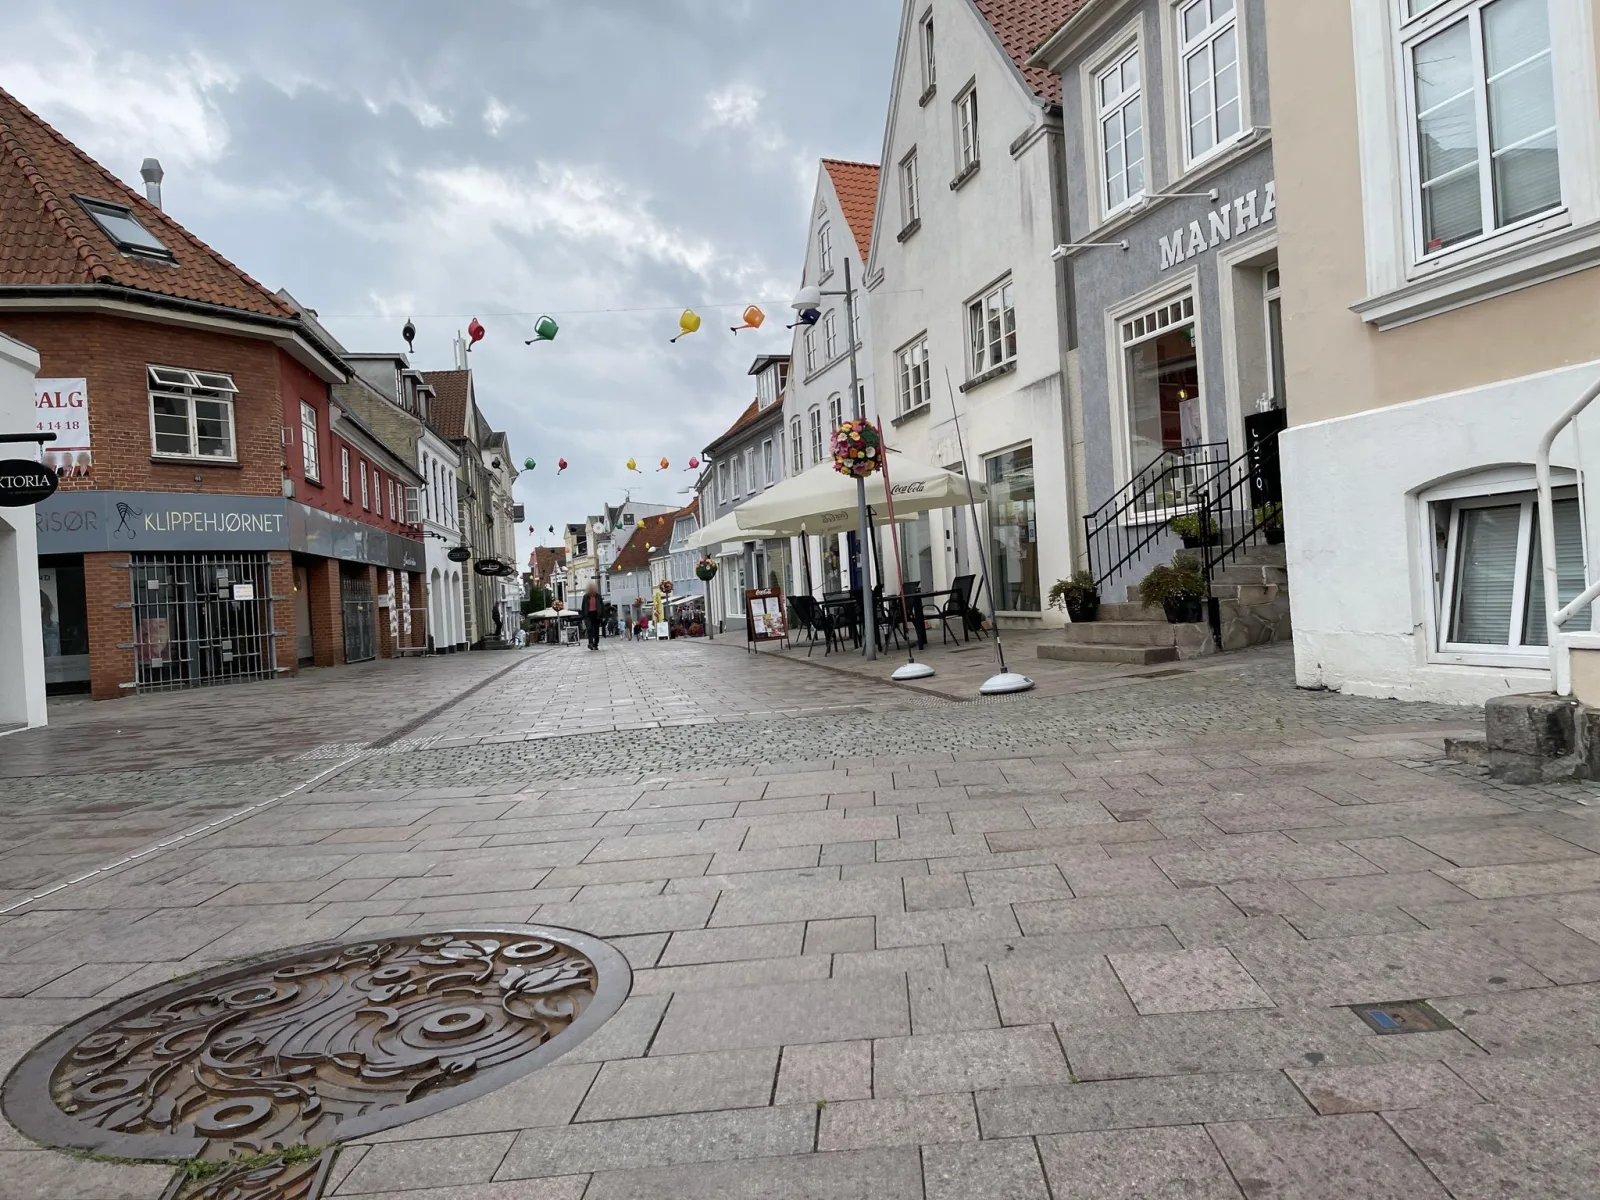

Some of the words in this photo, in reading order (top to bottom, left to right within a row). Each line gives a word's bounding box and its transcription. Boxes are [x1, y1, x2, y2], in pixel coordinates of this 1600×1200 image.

[48, 421, 61, 430] 14
[66, 421, 80, 430] 18
[144, 511, 284, 533] KLIPPEHJØRNET
